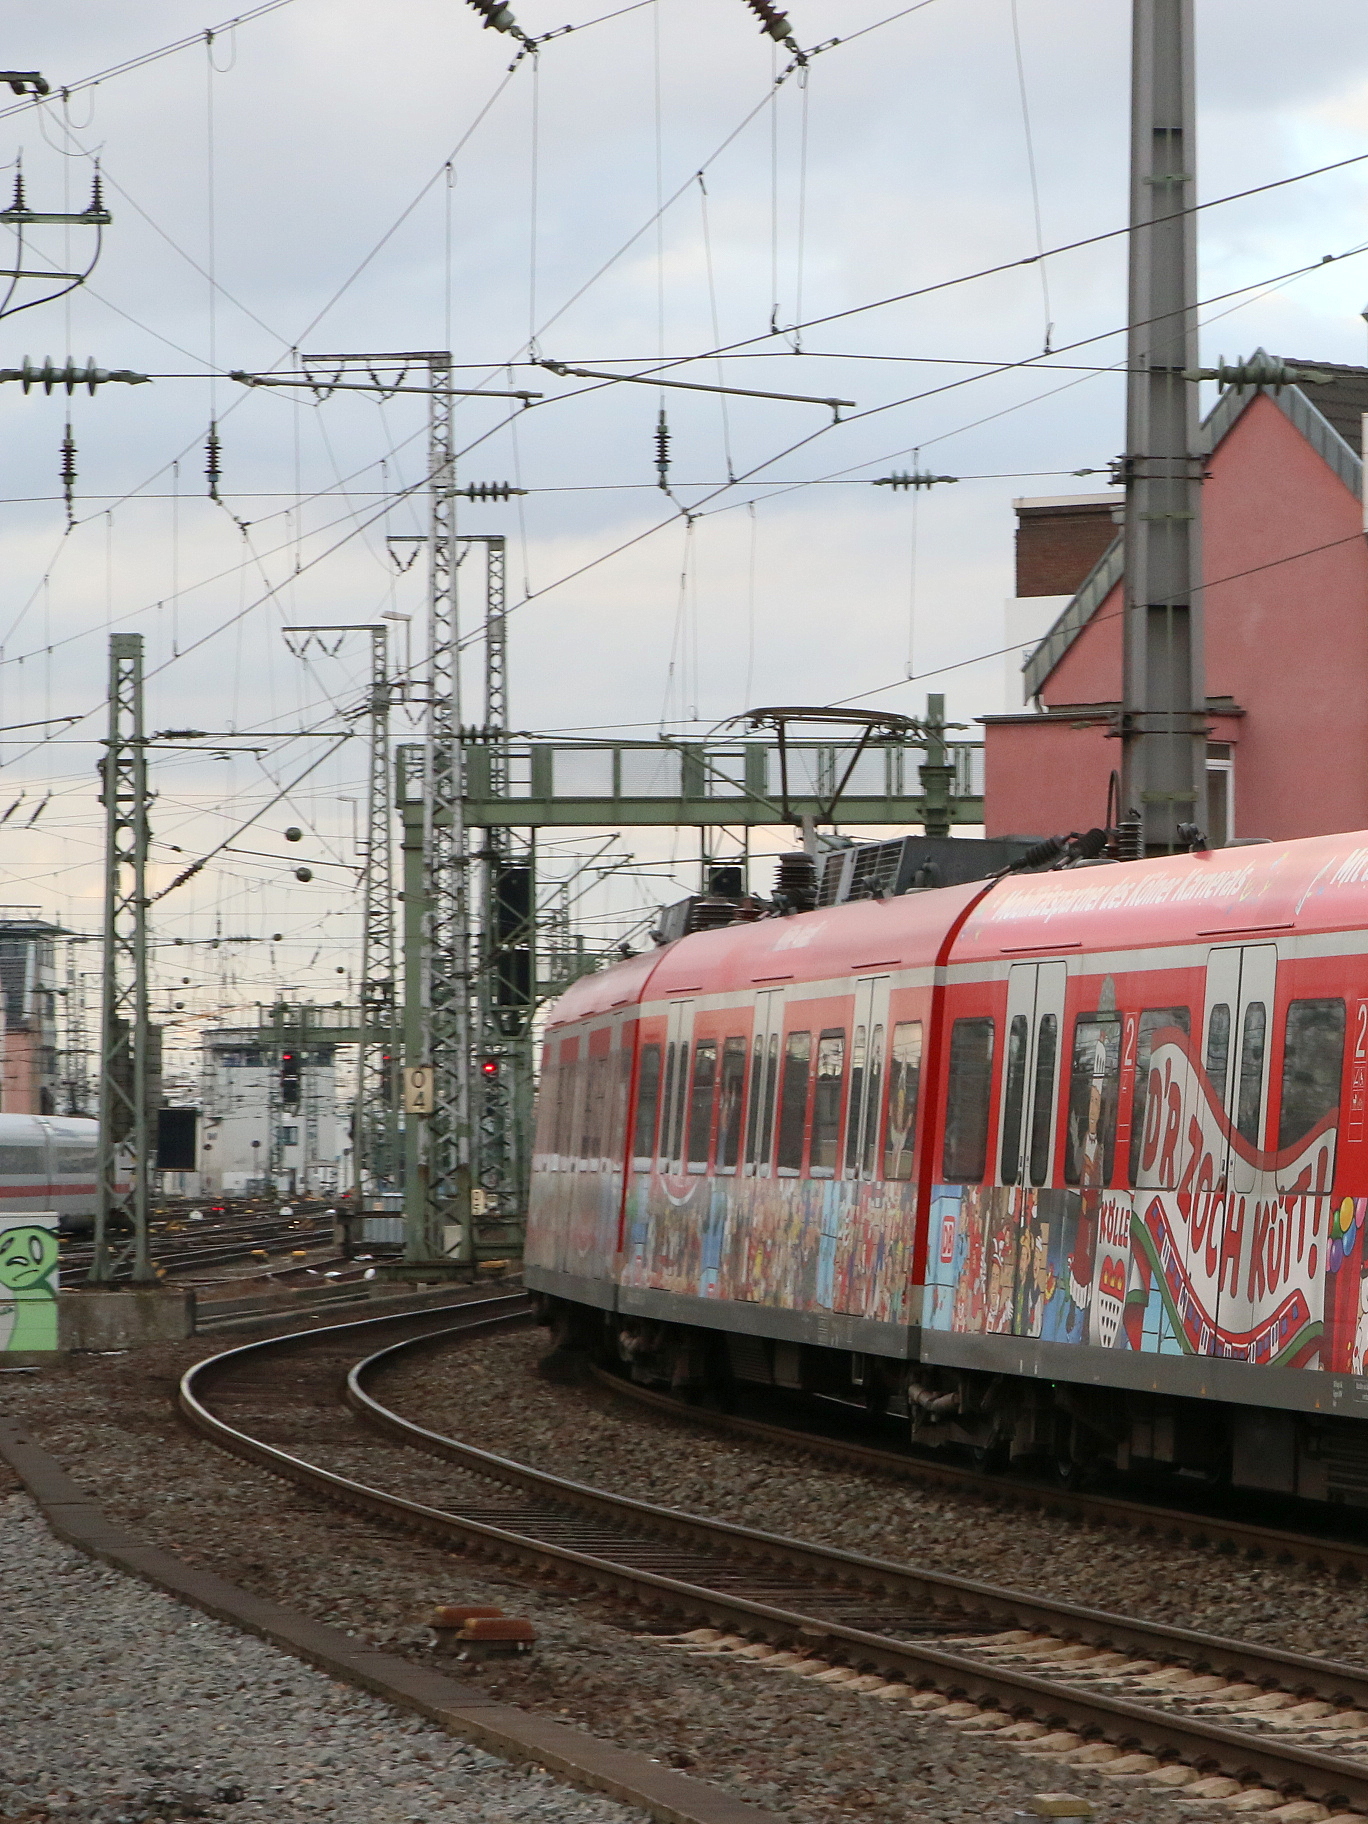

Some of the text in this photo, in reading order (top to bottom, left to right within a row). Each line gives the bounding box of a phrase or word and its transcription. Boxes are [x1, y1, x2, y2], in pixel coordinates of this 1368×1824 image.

[1125, 1017, 1135, 1067] 2
[1355, 1004, 1368, 1058] 2
[1098, 1197, 1131, 1249] KÖLLE
[1176, 1113, 1245, 1299] ZOCH
